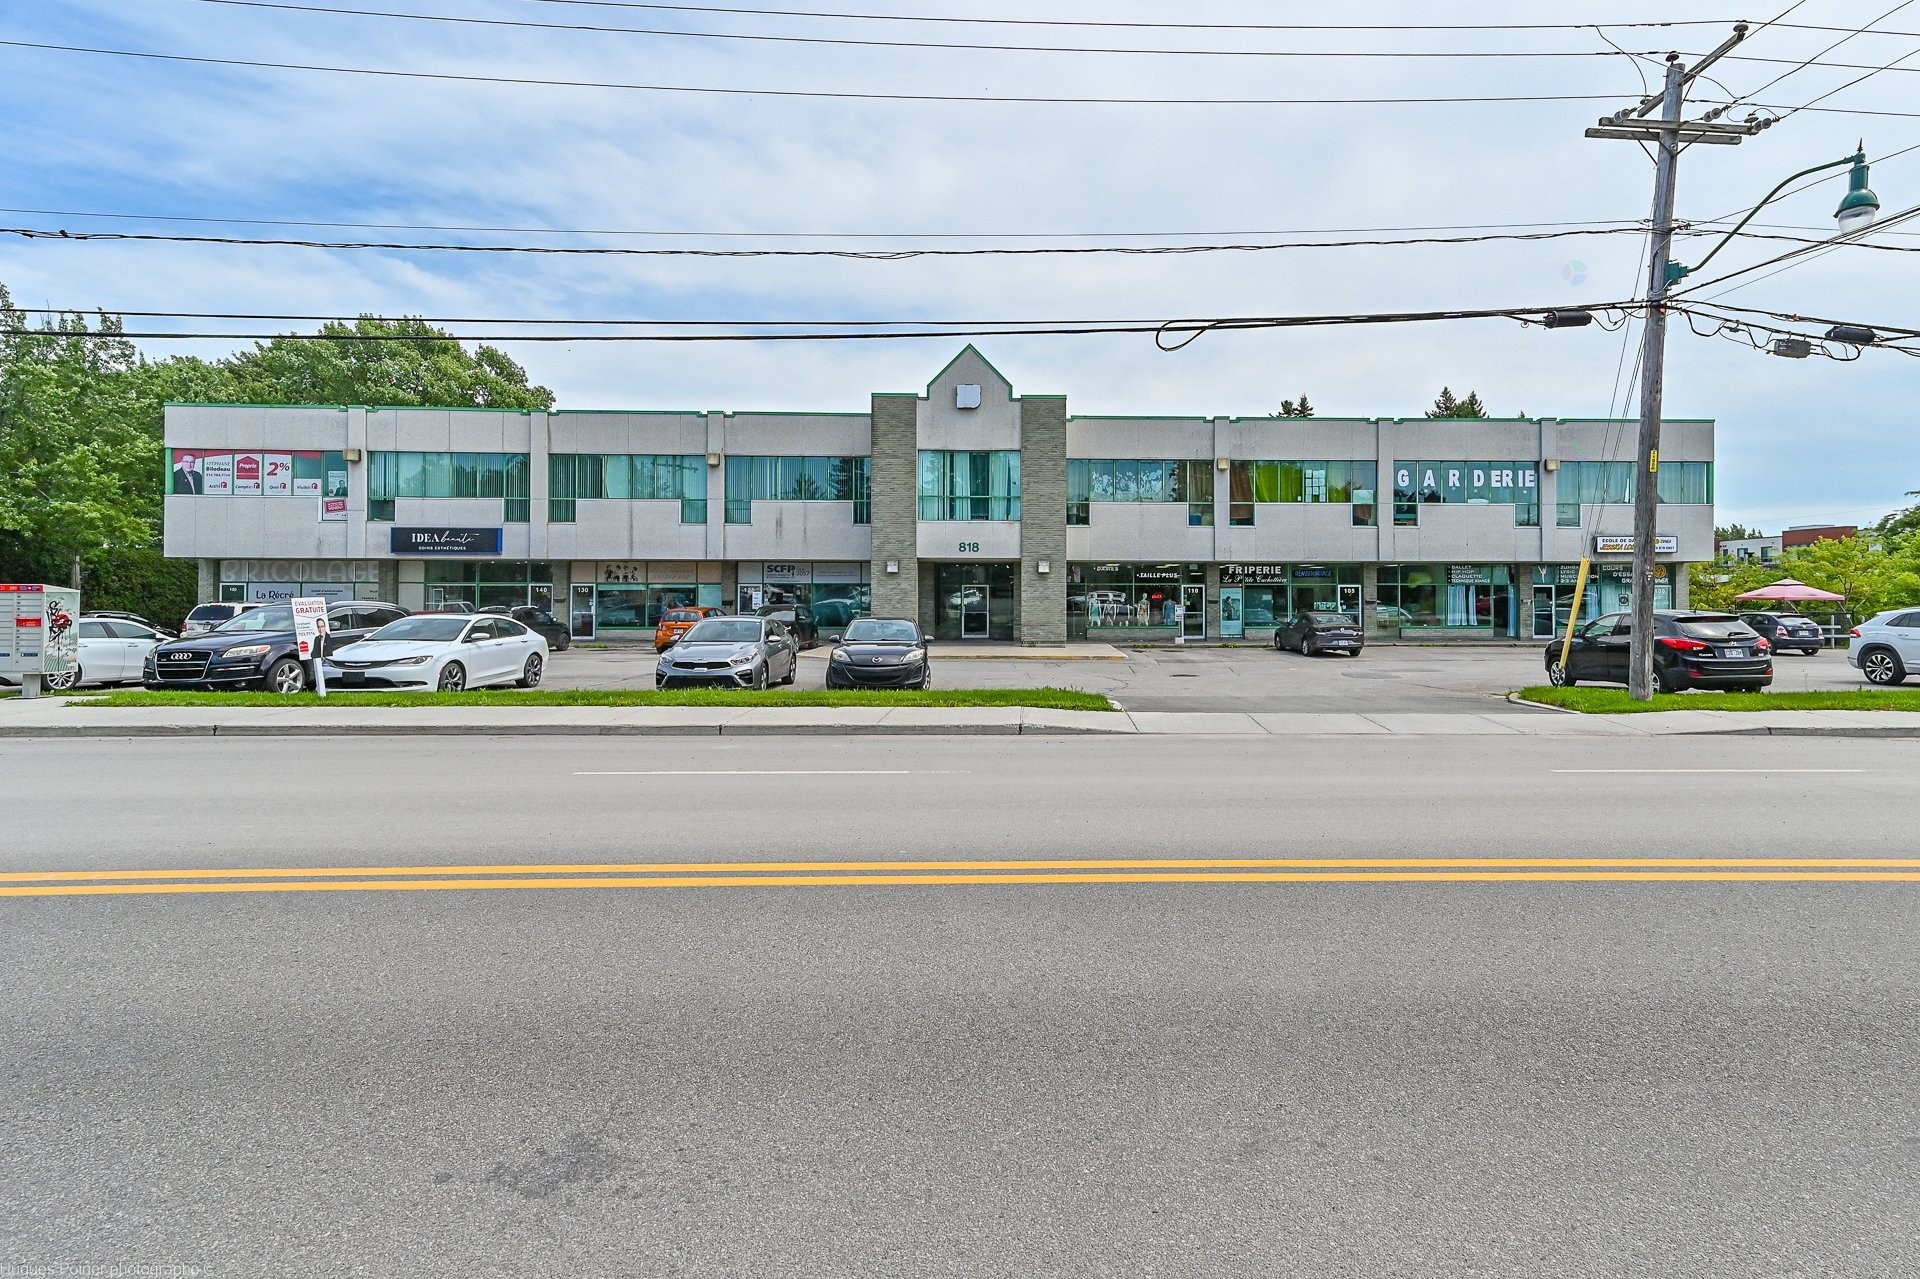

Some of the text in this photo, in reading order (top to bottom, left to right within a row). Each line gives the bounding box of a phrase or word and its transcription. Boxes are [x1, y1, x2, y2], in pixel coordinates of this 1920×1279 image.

[239, 462, 258, 470] Proprio
[266, 461, 291, 477] 2%
[1397, 469, 1536, 488] GARDERIE
[411, 533, 440, 543] IDEA
[958, 541, 980, 553] 818
[221, 560, 379, 583] BRICOLAGE
[766, 564, 796, 573] SCFP
[1228, 565, 1282, 575] FRIPERIE
[255, 590, 295, 601] La Récré
[295, 606, 325, 614] GRATUITE
